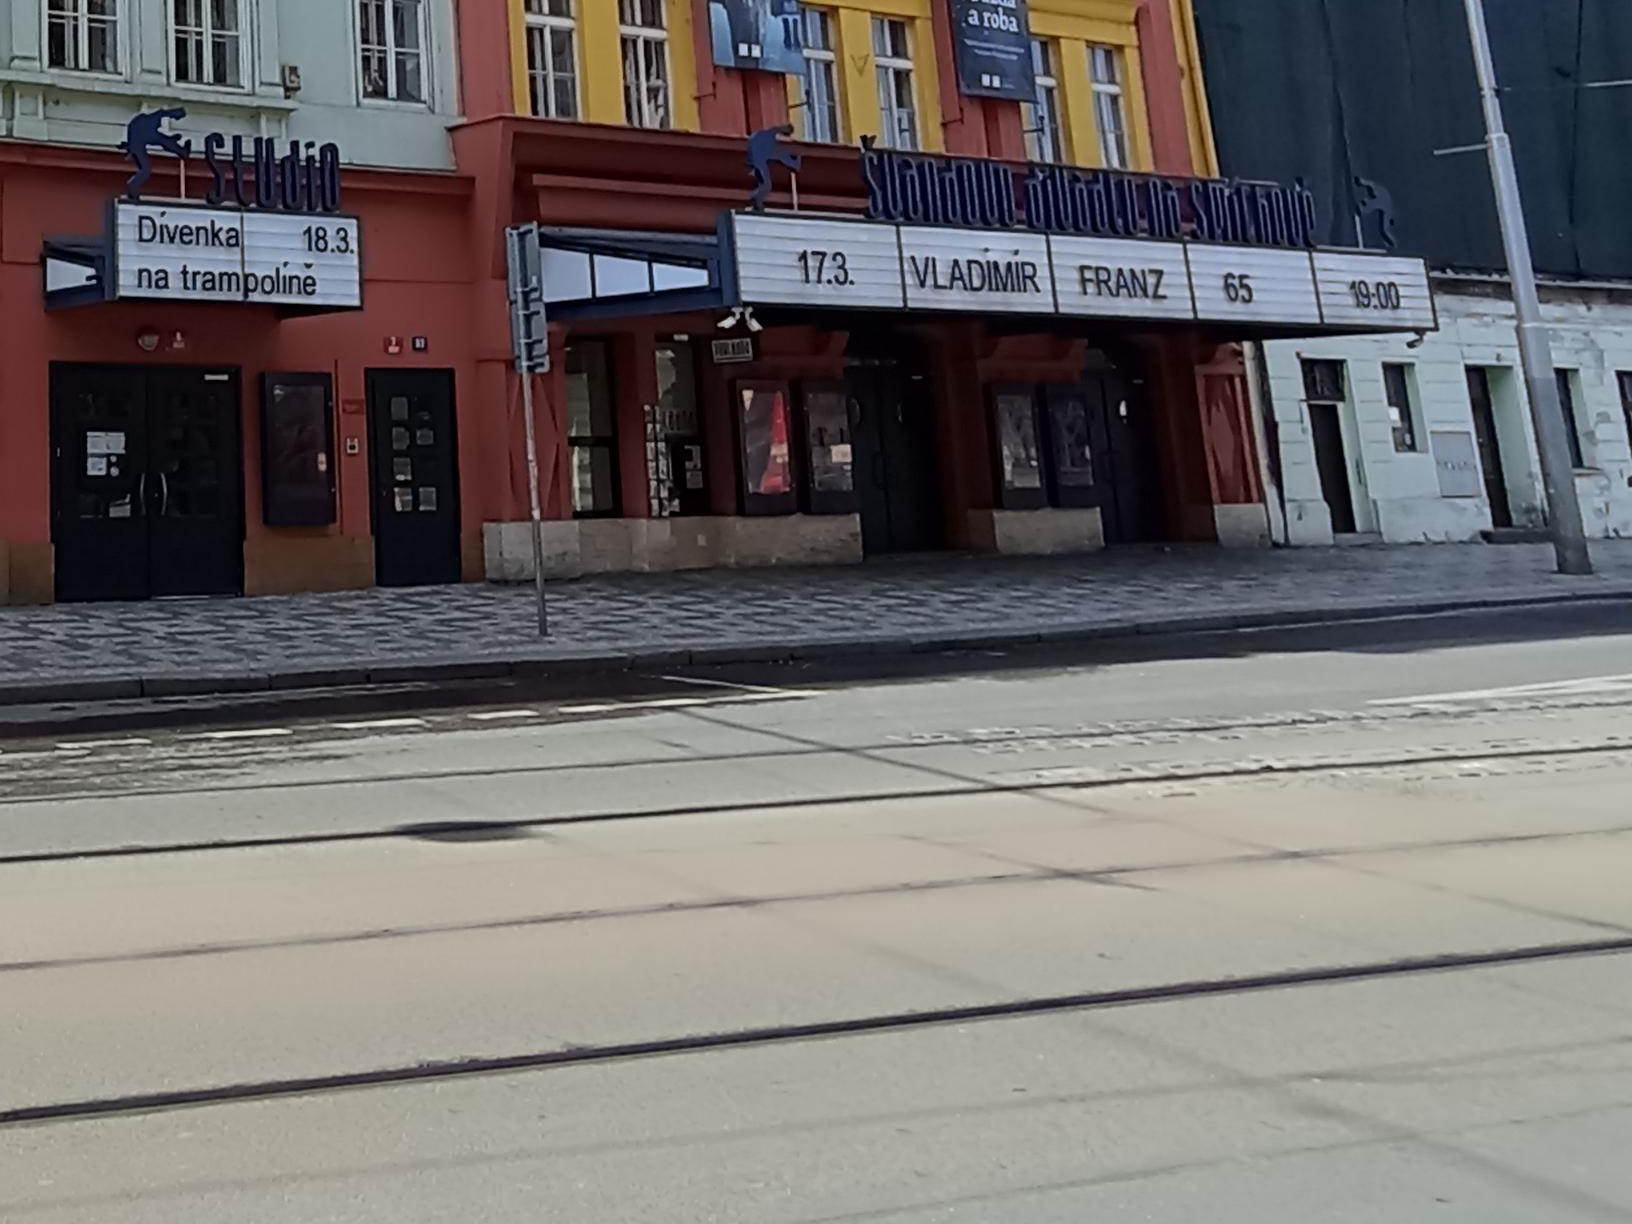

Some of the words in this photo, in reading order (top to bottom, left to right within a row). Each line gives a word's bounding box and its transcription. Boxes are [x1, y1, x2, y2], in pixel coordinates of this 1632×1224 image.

[968, 8, 980, 26] a
[982, 7, 1020, 33] roba
[137, 210, 240, 248] Dívenka
[302, 226, 356, 255] 18.3.
[137, 267, 169, 290] na
[180, 260, 317, 300] trampolíně
[797, 249, 856, 286] 17.3.
[1078, 264, 1168, 300] FRANZ
[1223, 272, 1254, 304] 65
[1348, 279, 1401, 311] 19:00
